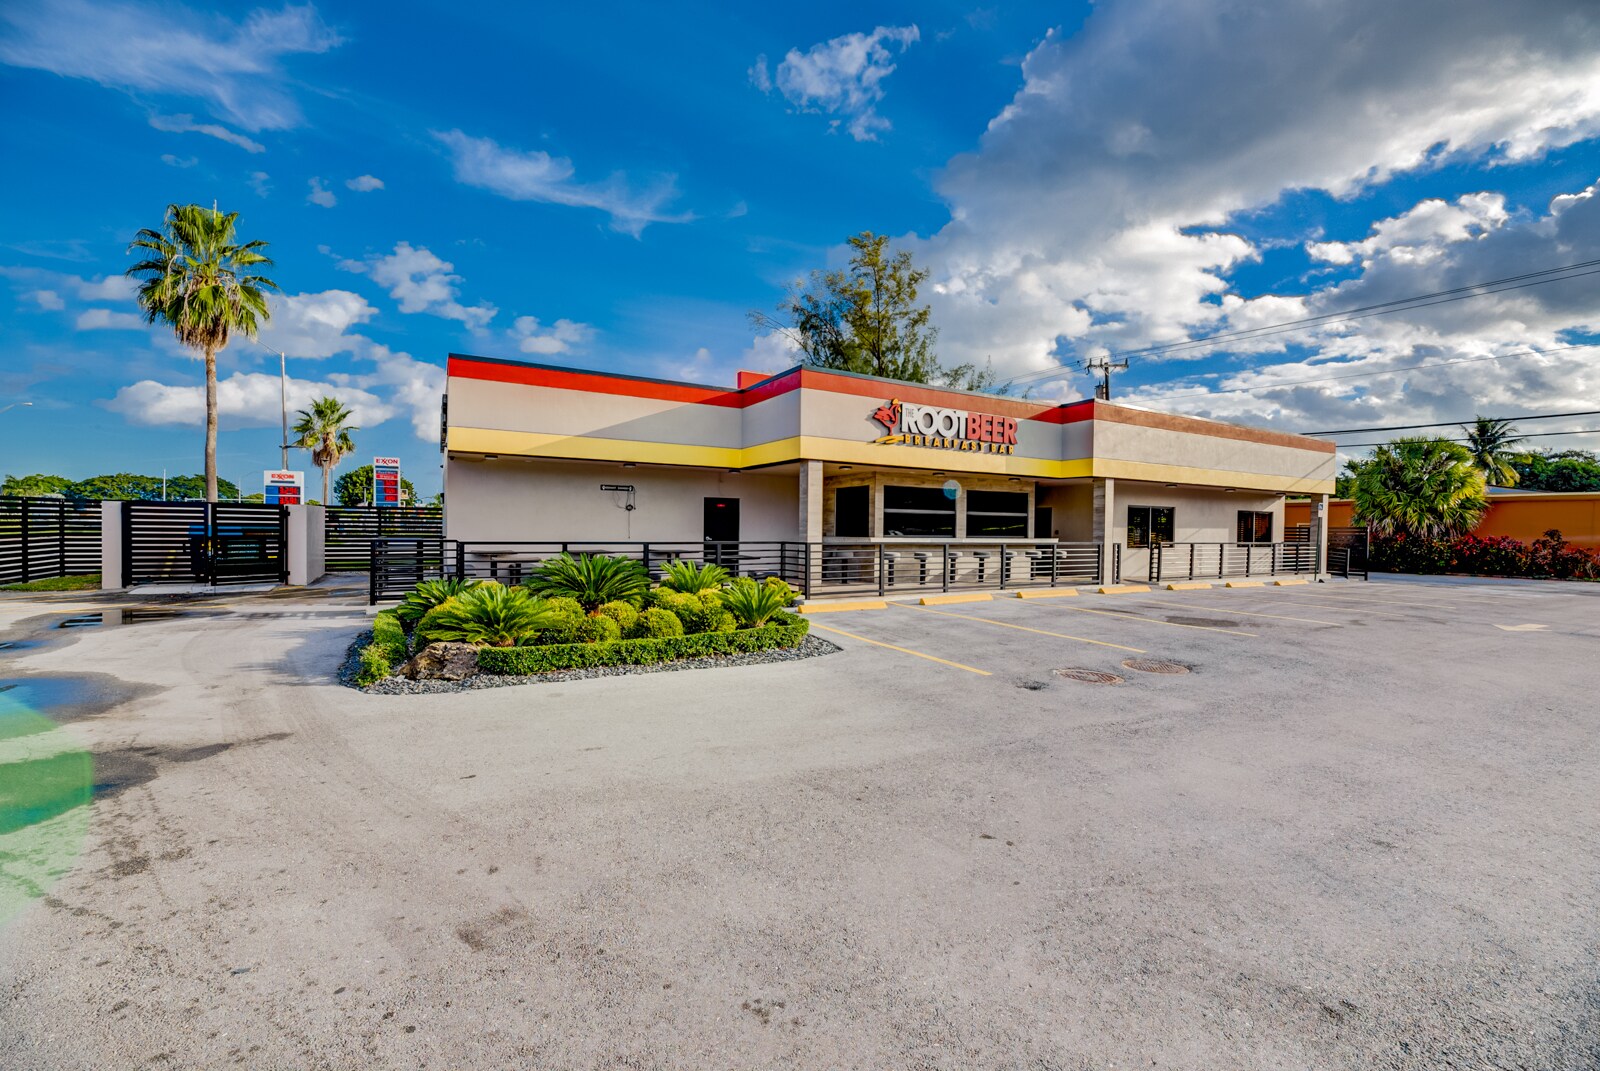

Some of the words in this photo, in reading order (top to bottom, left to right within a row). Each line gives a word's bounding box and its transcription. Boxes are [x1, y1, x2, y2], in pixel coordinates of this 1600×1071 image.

[905, 408, 914, 418] THE
[904, 434, 985, 452] BREAKFAST
[990, 444, 1014, 455] BAR
